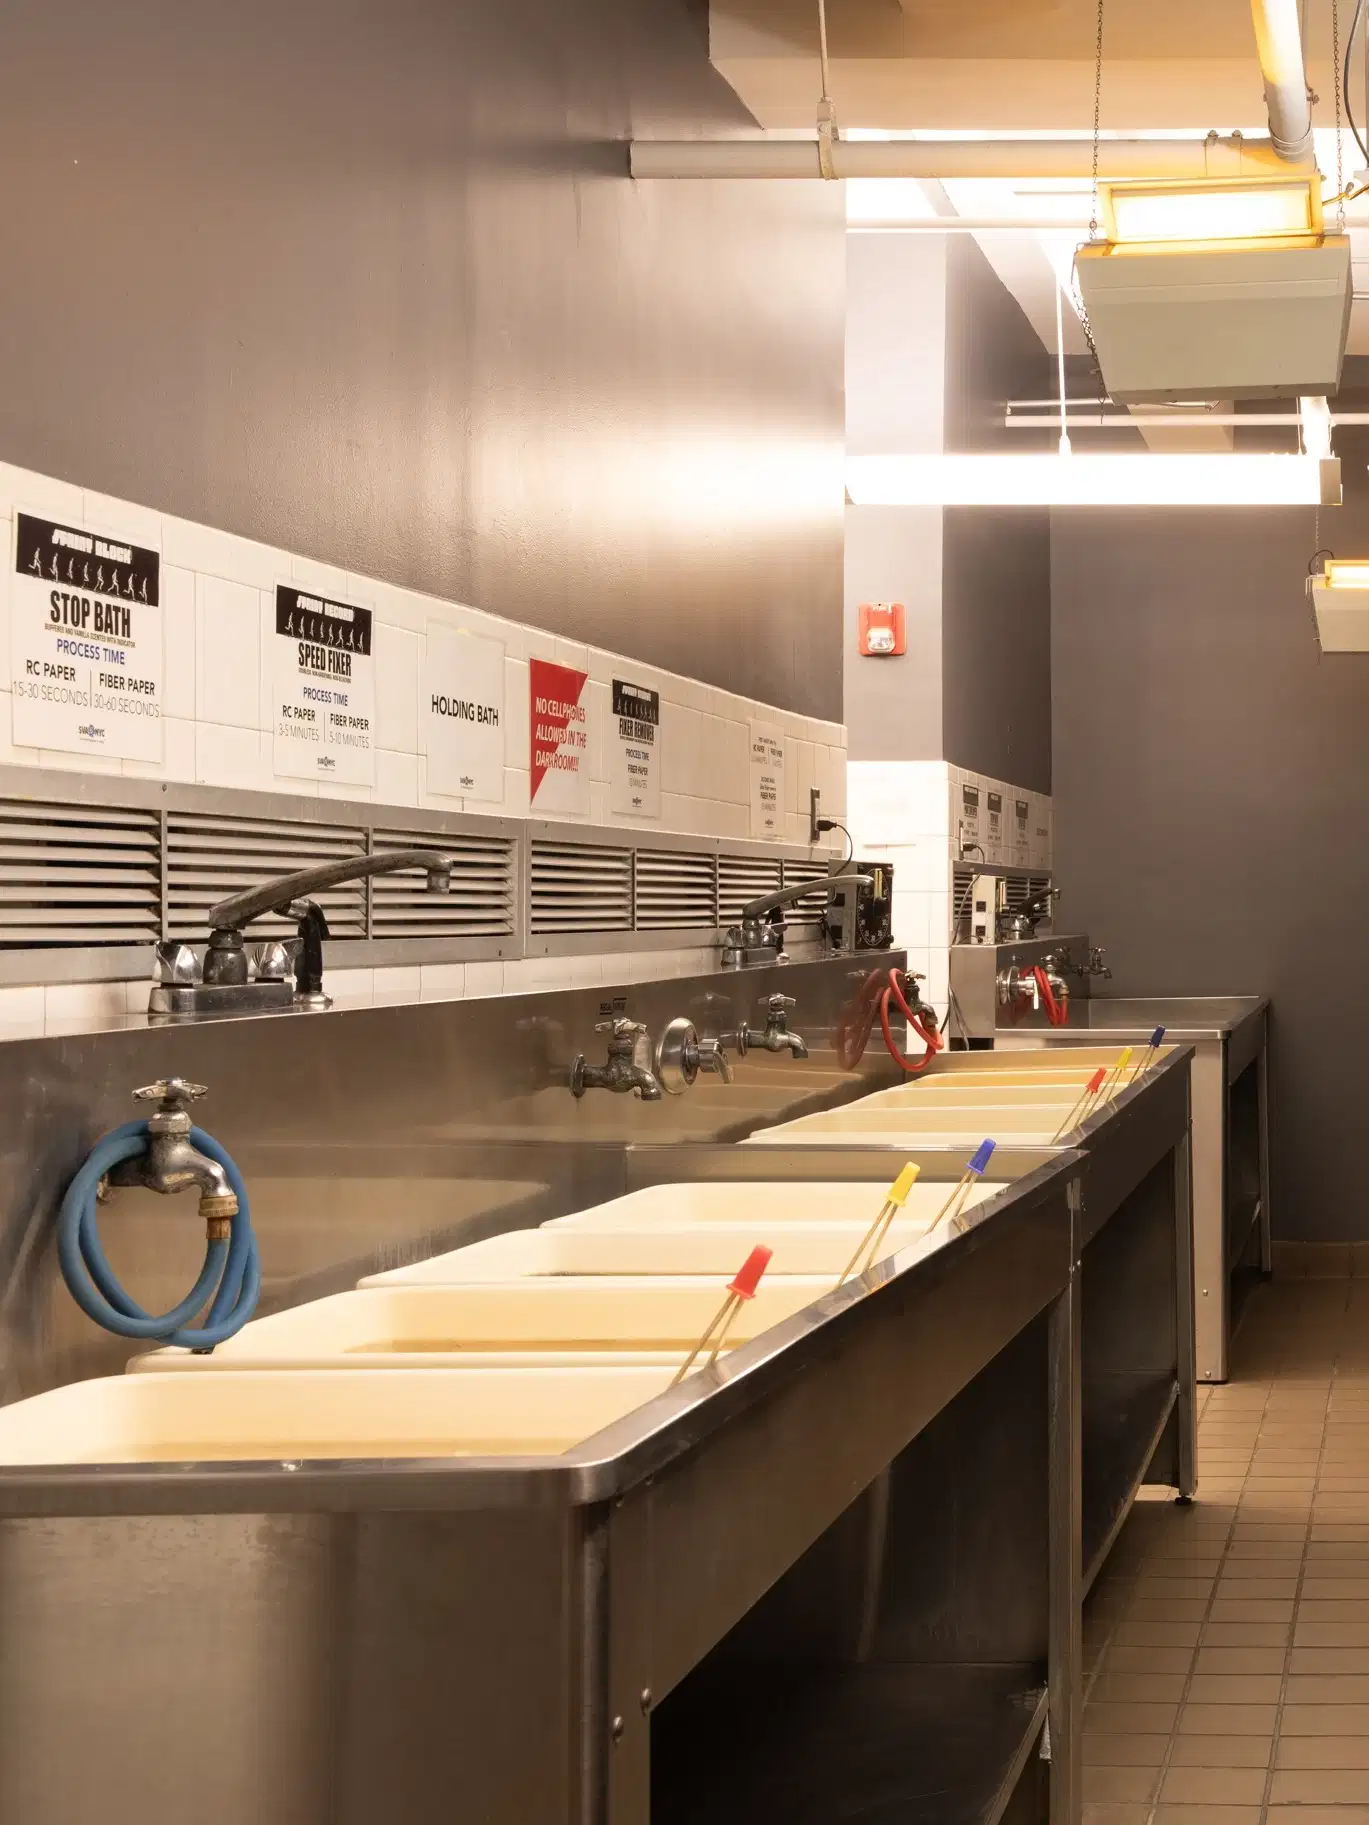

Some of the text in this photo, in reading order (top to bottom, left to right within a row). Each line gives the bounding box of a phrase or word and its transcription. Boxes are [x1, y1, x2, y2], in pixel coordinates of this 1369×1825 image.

[50, 590, 131, 638] STOP BATH
[57, 639, 125, 665] PROCESS TIME
[298, 642, 352, 677] SPEED FIXER
[26, 659, 76, 681] RC PAPER
[12, 681, 88, 707] 15-30 SECONDS
[99, 672, 155, 695] FIBER PAPER
[94, 694, 160, 718] 30-60 SECONDS
[303, 687, 348, 706] PROCESS TIME
[282, 705, 315, 721] RC PAPER
[431, 694, 499, 726] HOLDING BATH
[536, 696, 586, 723] NO CELLPHONES
[290, 725, 320, 741] MINUTES
[329, 713, 369, 731] FIBER PAPER
[342, 734, 370, 749] MINUTES
[536, 724, 587, 748] ALLOWED IN THE
